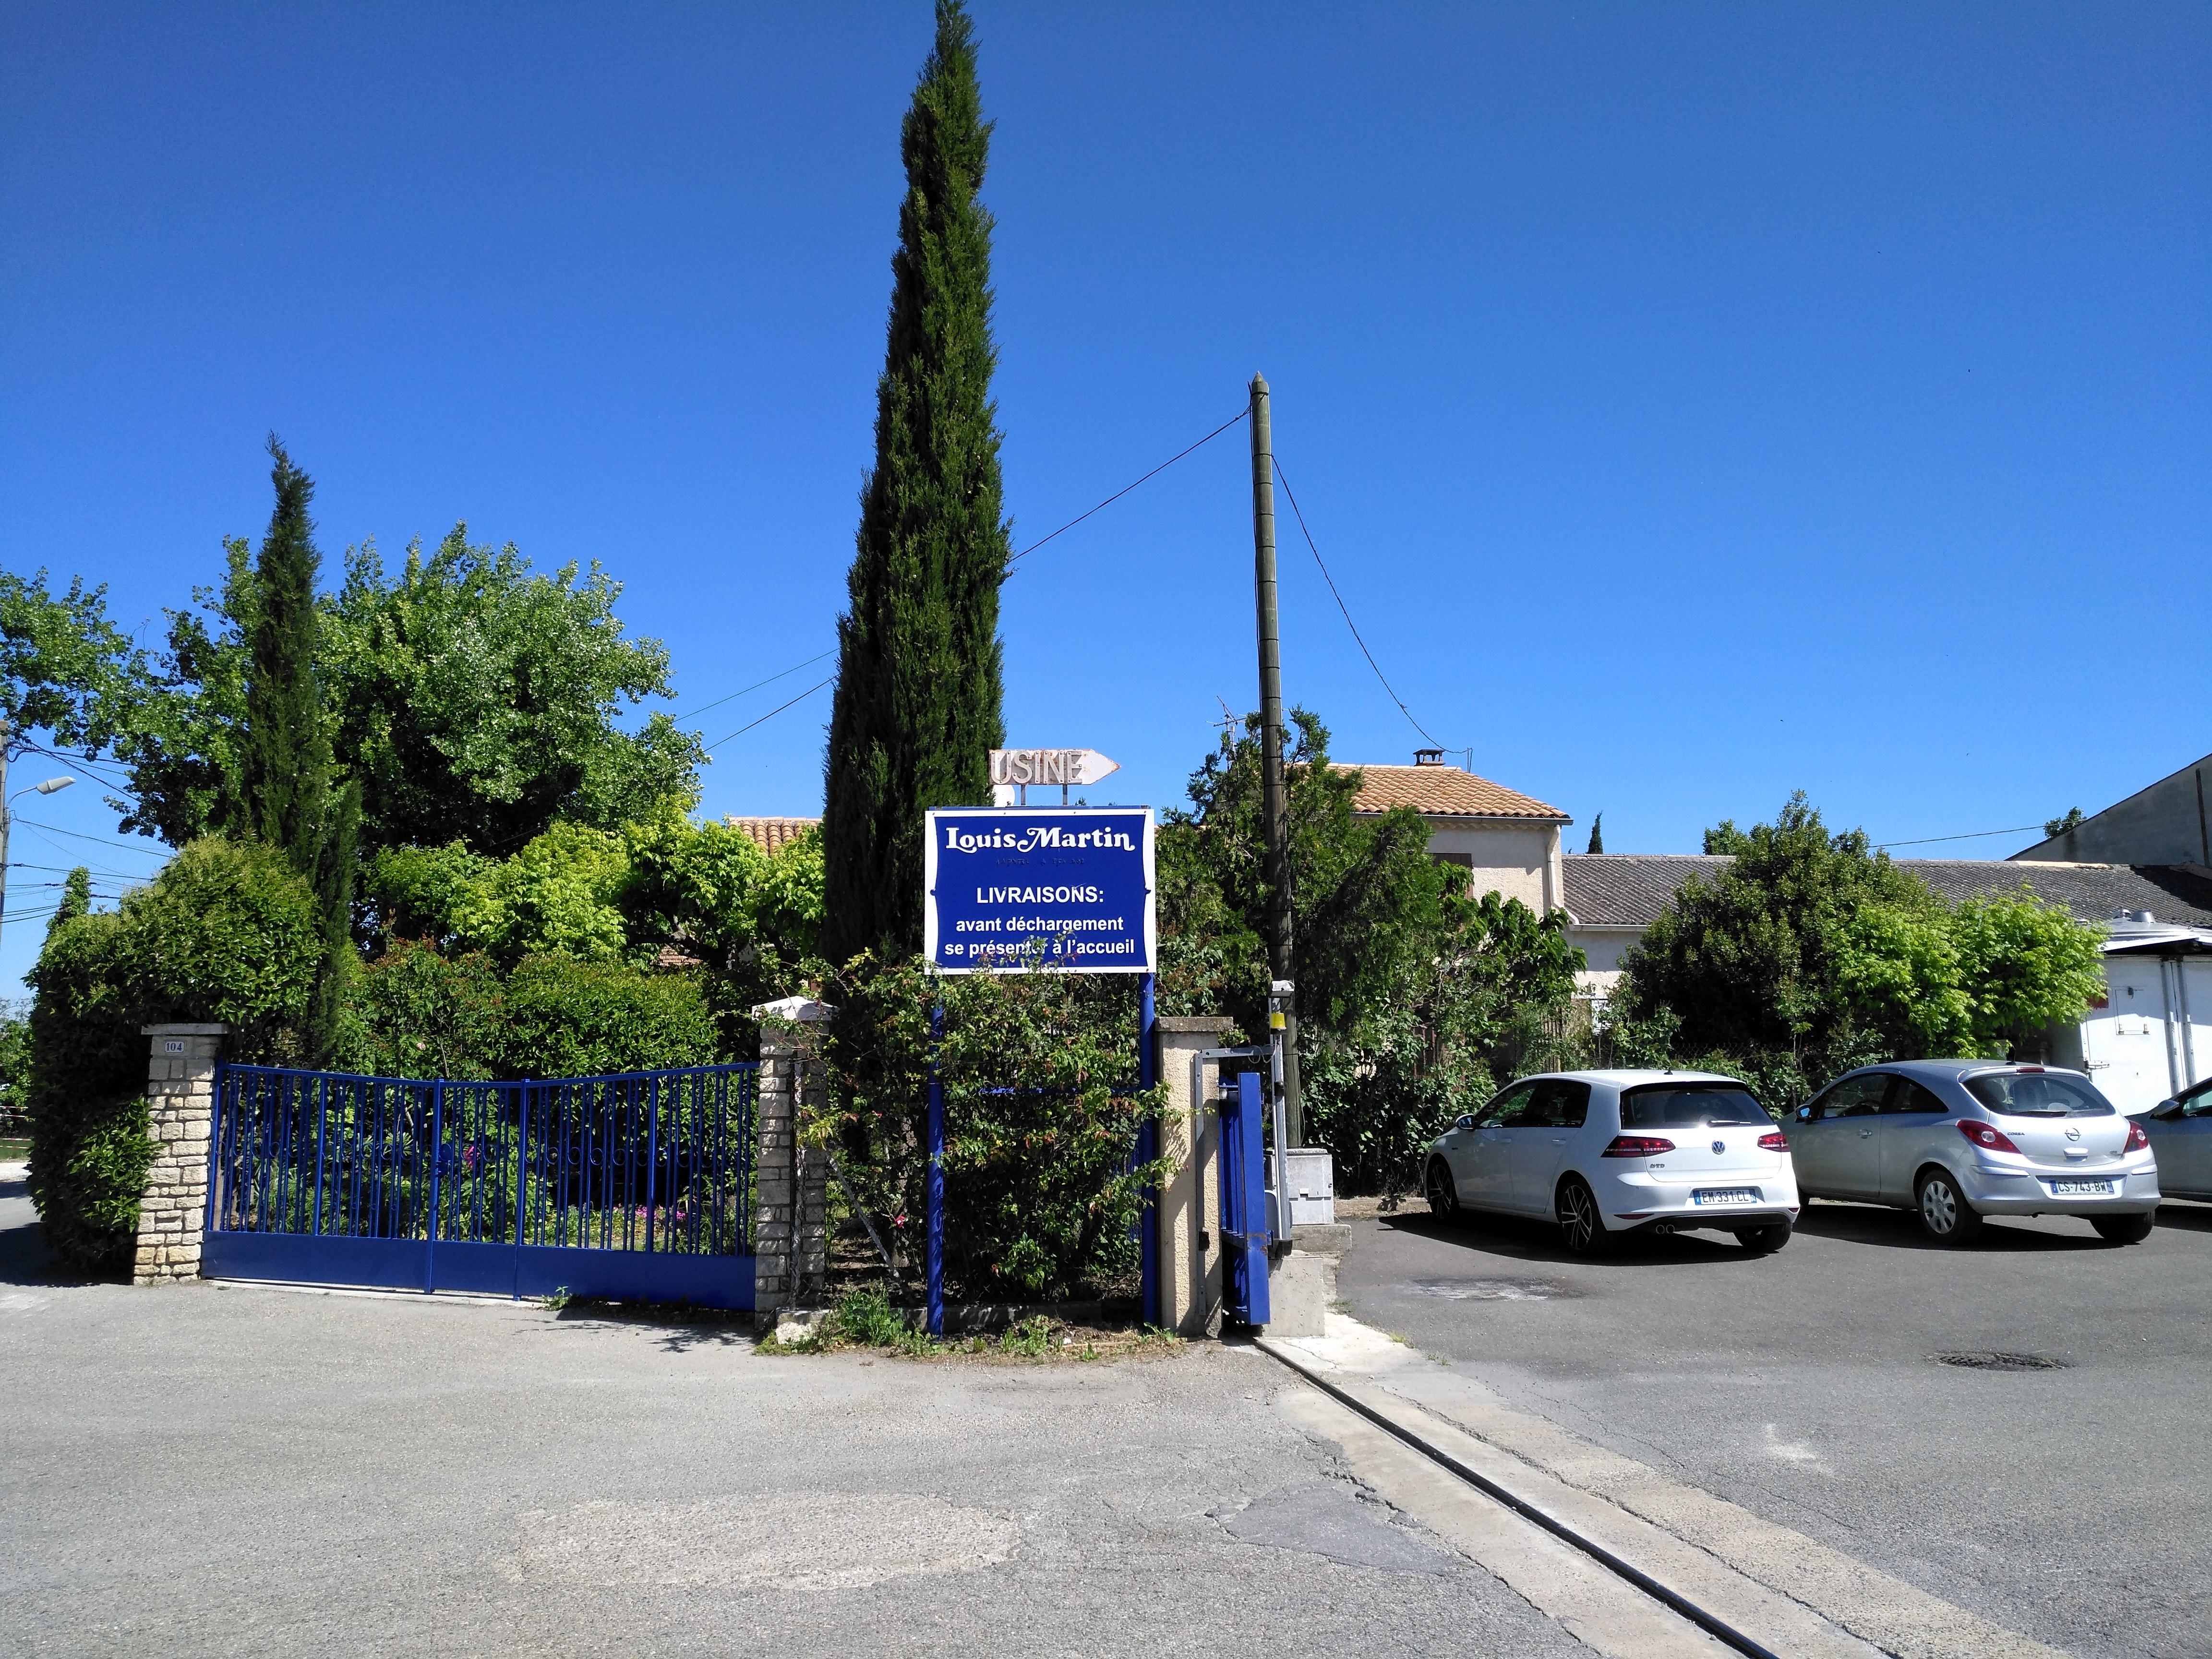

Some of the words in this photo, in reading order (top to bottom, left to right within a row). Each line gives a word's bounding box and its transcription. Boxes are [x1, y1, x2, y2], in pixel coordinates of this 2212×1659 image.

[991, 750, 1082, 784] USINE
[946, 827, 1016, 854] Louis
[1017, 826, 1135, 853] Martin
[977, 886, 1104, 903] LIVRAISONS:
[956, 917, 1002, 932] avant
[1006, 916, 1124, 933] déchargement
[944, 943, 964, 955] se
[1052, 939, 1062, 954] à
[167, 1043, 182, 1051] 104
